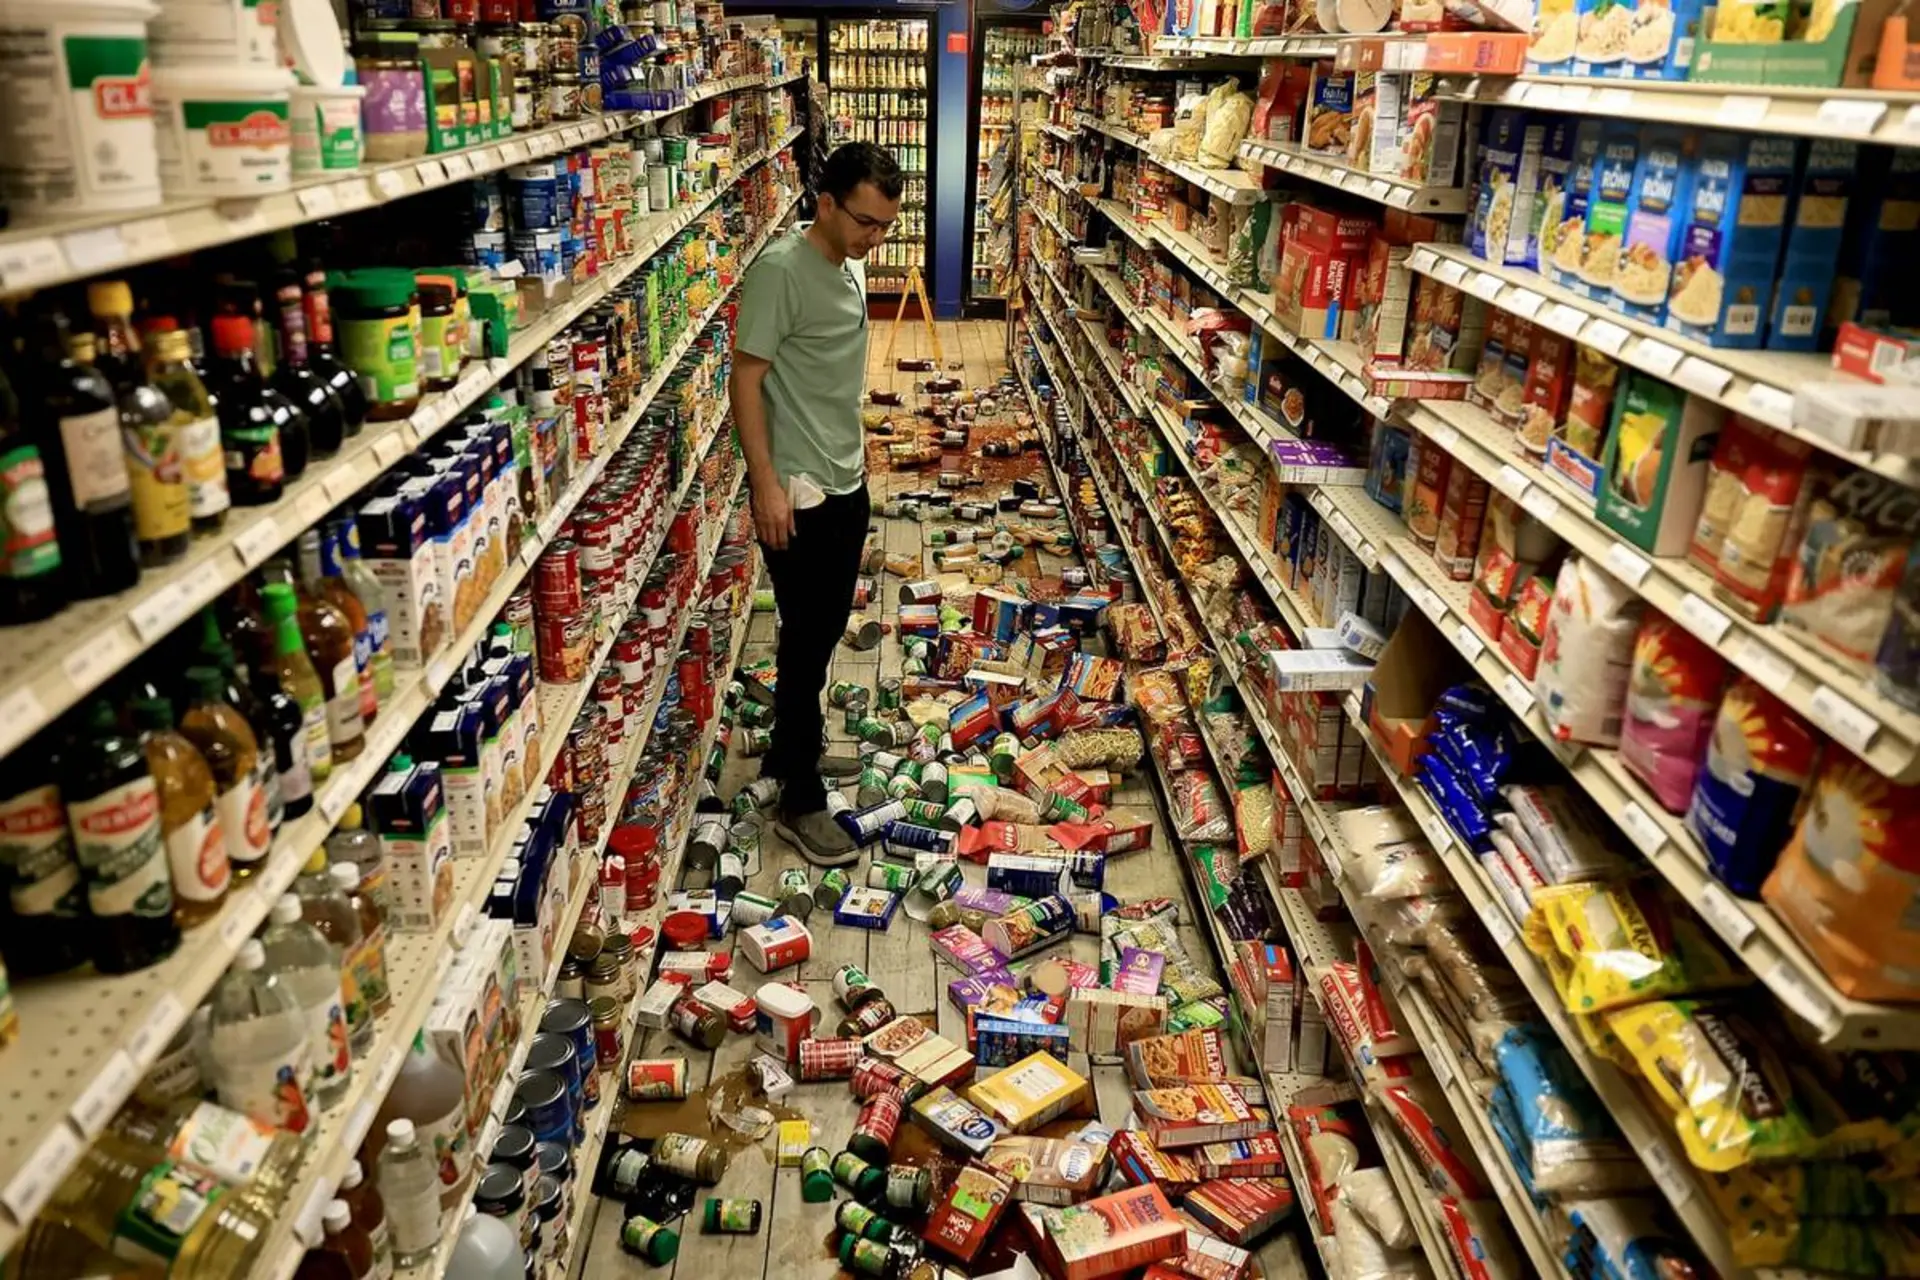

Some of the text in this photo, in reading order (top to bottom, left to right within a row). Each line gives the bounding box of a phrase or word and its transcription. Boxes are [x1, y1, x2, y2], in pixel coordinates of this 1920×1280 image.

[1744, 1071, 1773, 1115] RICE
[947, 1212, 975, 1234] RONI
[939, 1227, 966, 1246] RICE
